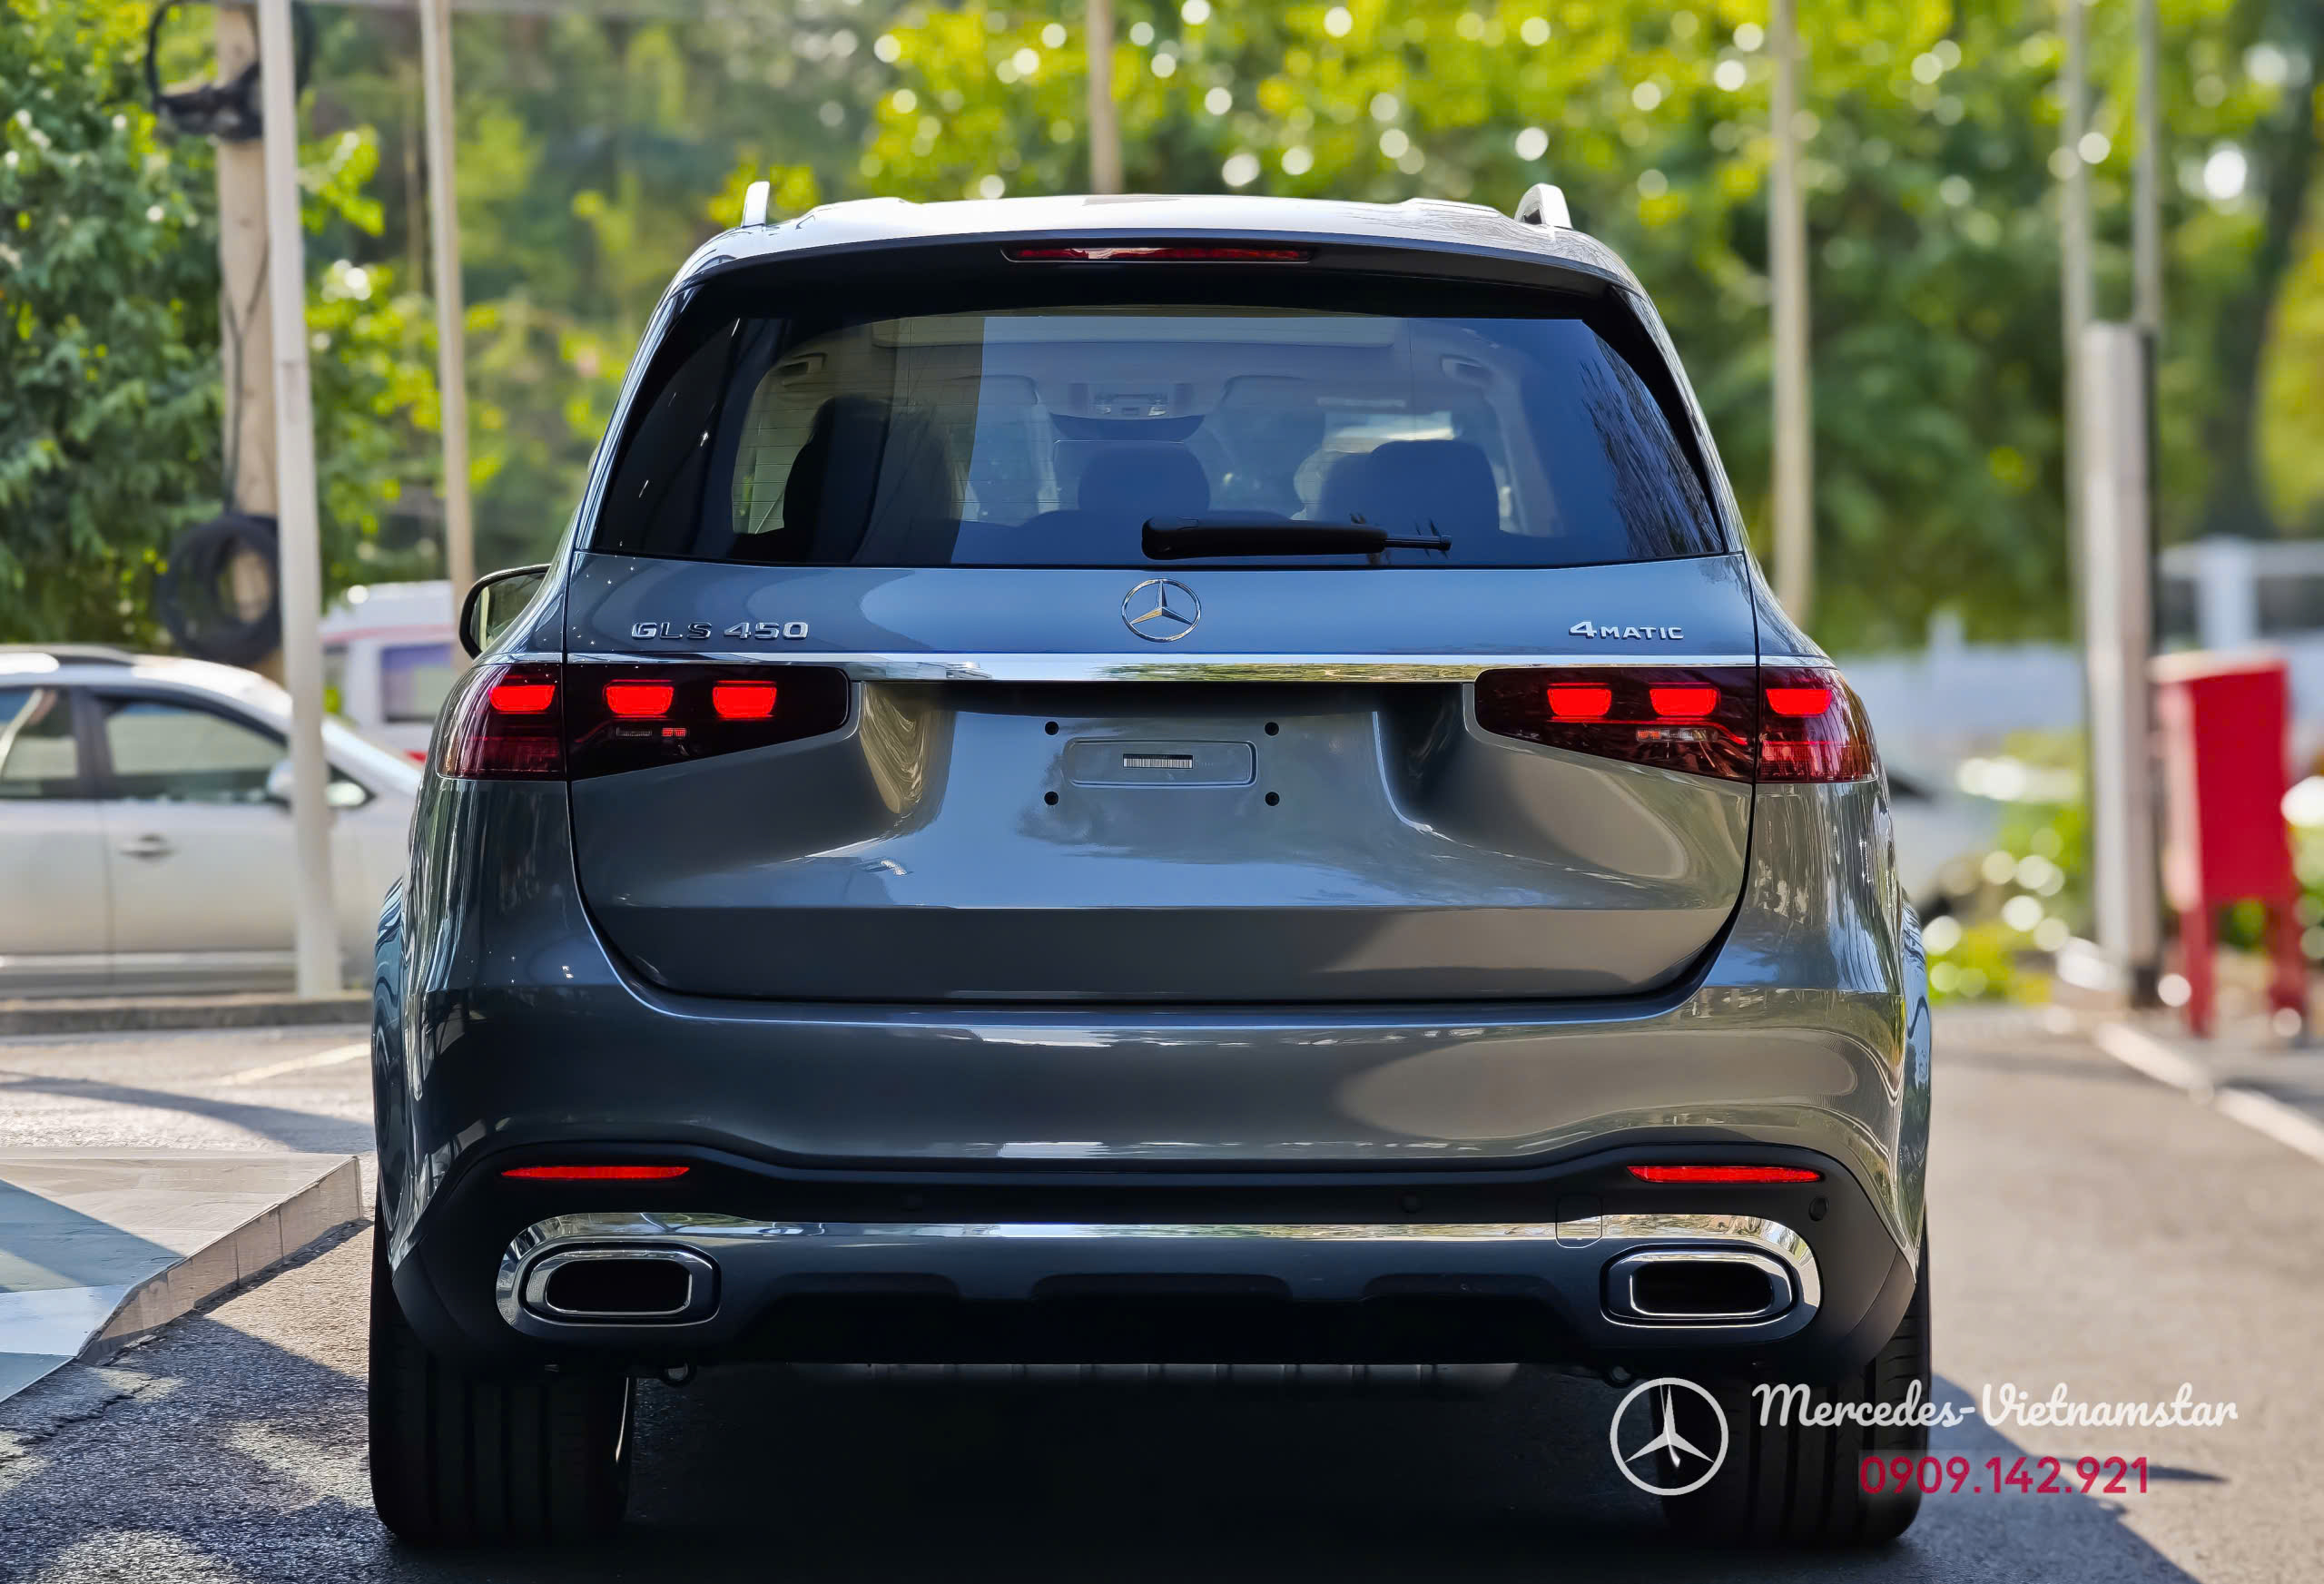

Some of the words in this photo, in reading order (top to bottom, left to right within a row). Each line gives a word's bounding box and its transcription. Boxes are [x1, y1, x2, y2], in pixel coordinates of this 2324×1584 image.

[631, 621, 713, 639] GLS
[724, 621, 809, 639] 450
[1569, 621, 1684, 640] 4MATIC
